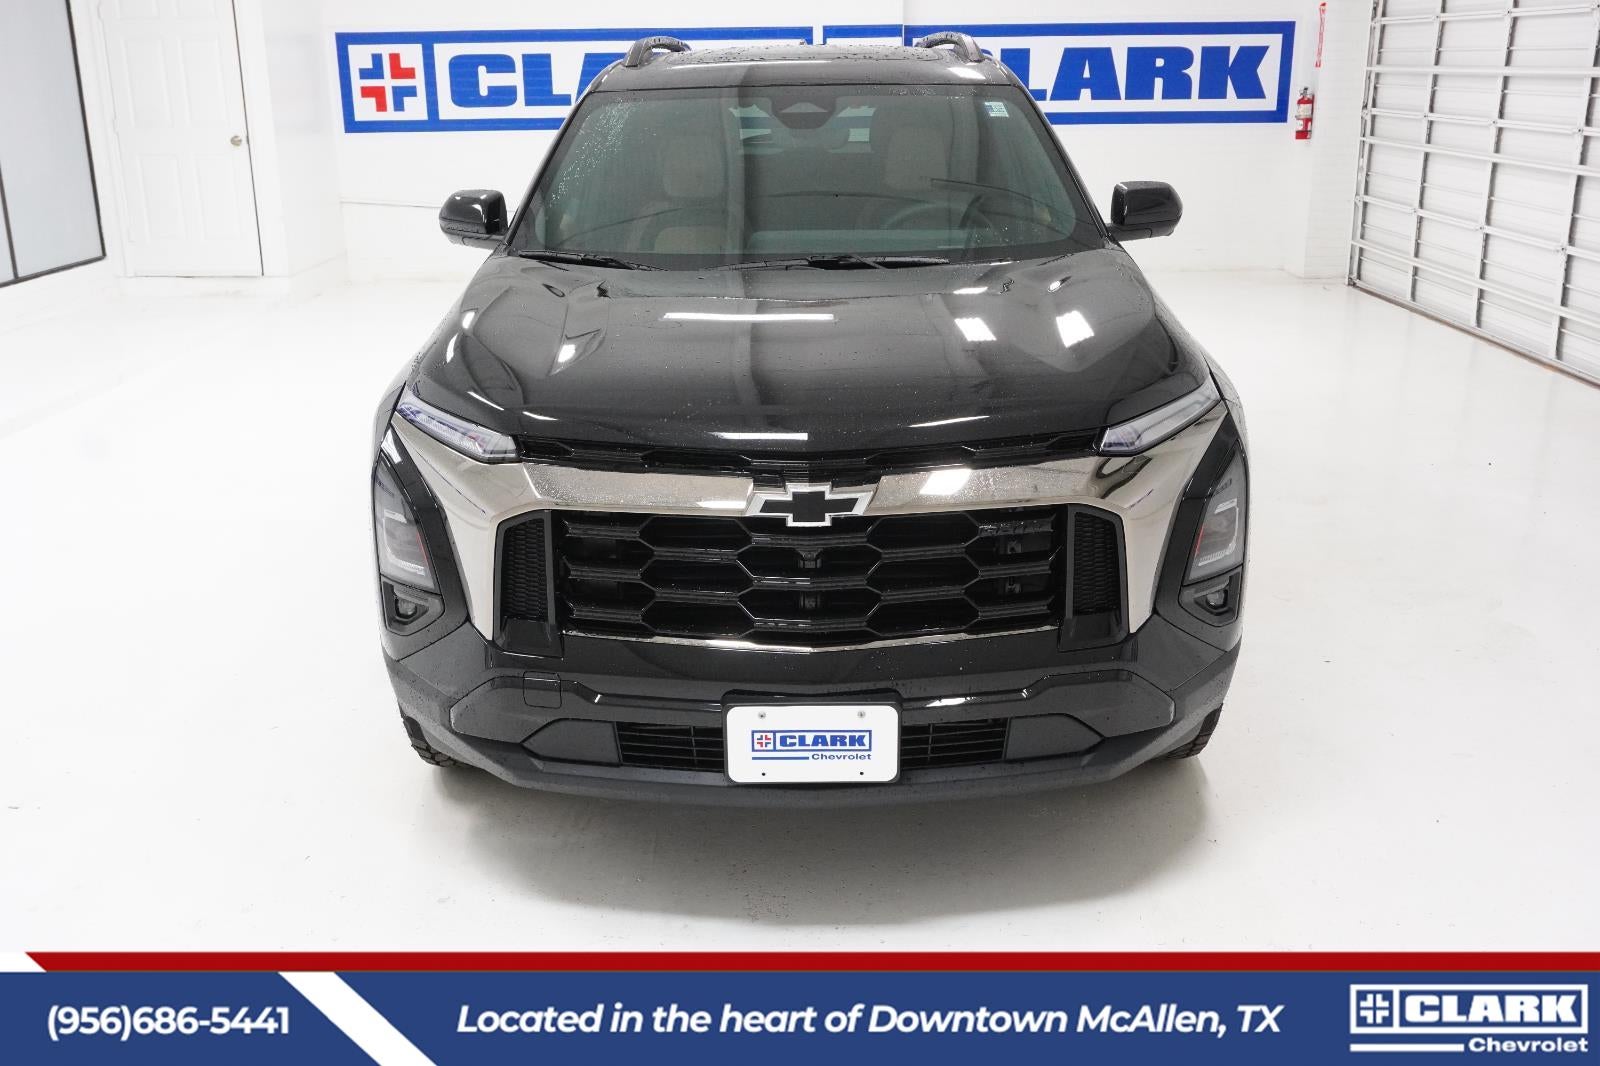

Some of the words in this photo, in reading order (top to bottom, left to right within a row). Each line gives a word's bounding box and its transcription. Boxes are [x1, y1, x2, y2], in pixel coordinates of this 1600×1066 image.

[980, 46, 1270, 101] LARK
[779, 734, 866, 748] CLARK
[811, 753, 872, 761] Chevrolet
